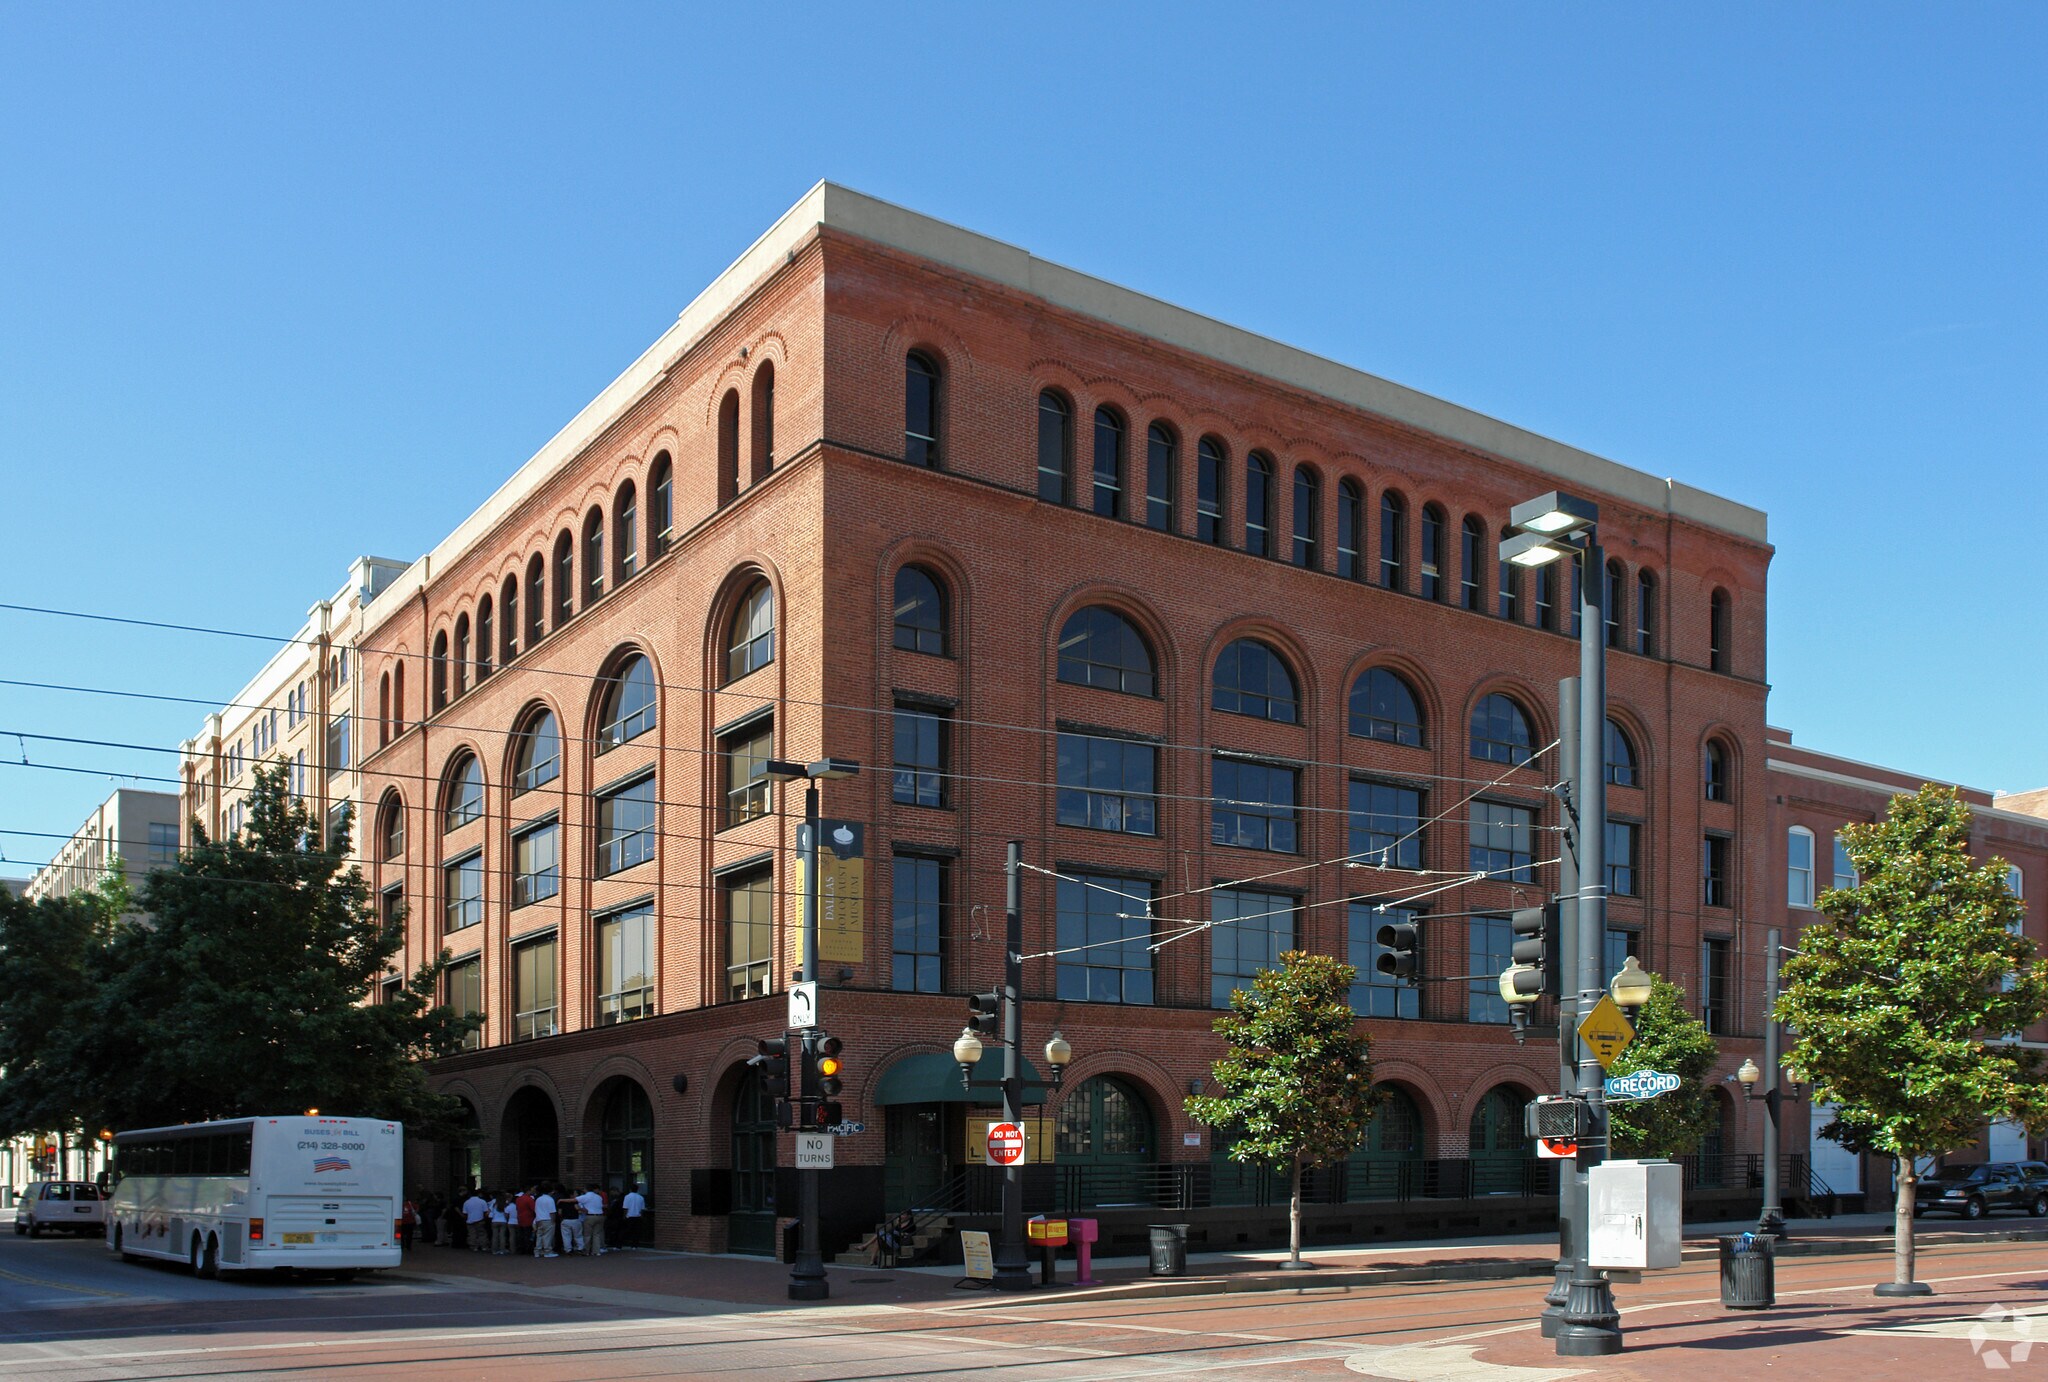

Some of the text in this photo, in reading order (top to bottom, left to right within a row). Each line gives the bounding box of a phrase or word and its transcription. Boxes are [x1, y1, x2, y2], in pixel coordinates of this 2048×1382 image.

[825, 876, 835, 921] DALLAS
[838, 865, 847, 935] HOLOCAUST
[850, 876, 859, 926] MUSEUM
[792, 1013, 810, 1024] ONLY
[1620, 1076, 1677, 1092] RECORD
[304, 1128, 331, 1136] BUSES
[827, 1123, 860, 1132] PACIFIC
[994, 1130, 1019, 1139] DO NOT
[297, 1141, 365, 1151] (214) 328-8000
[806, 1140, 823, 1150] NO
[993, 1149, 1017, 1157] ENTER
[798, 1154, 831, 1163] TURNS
